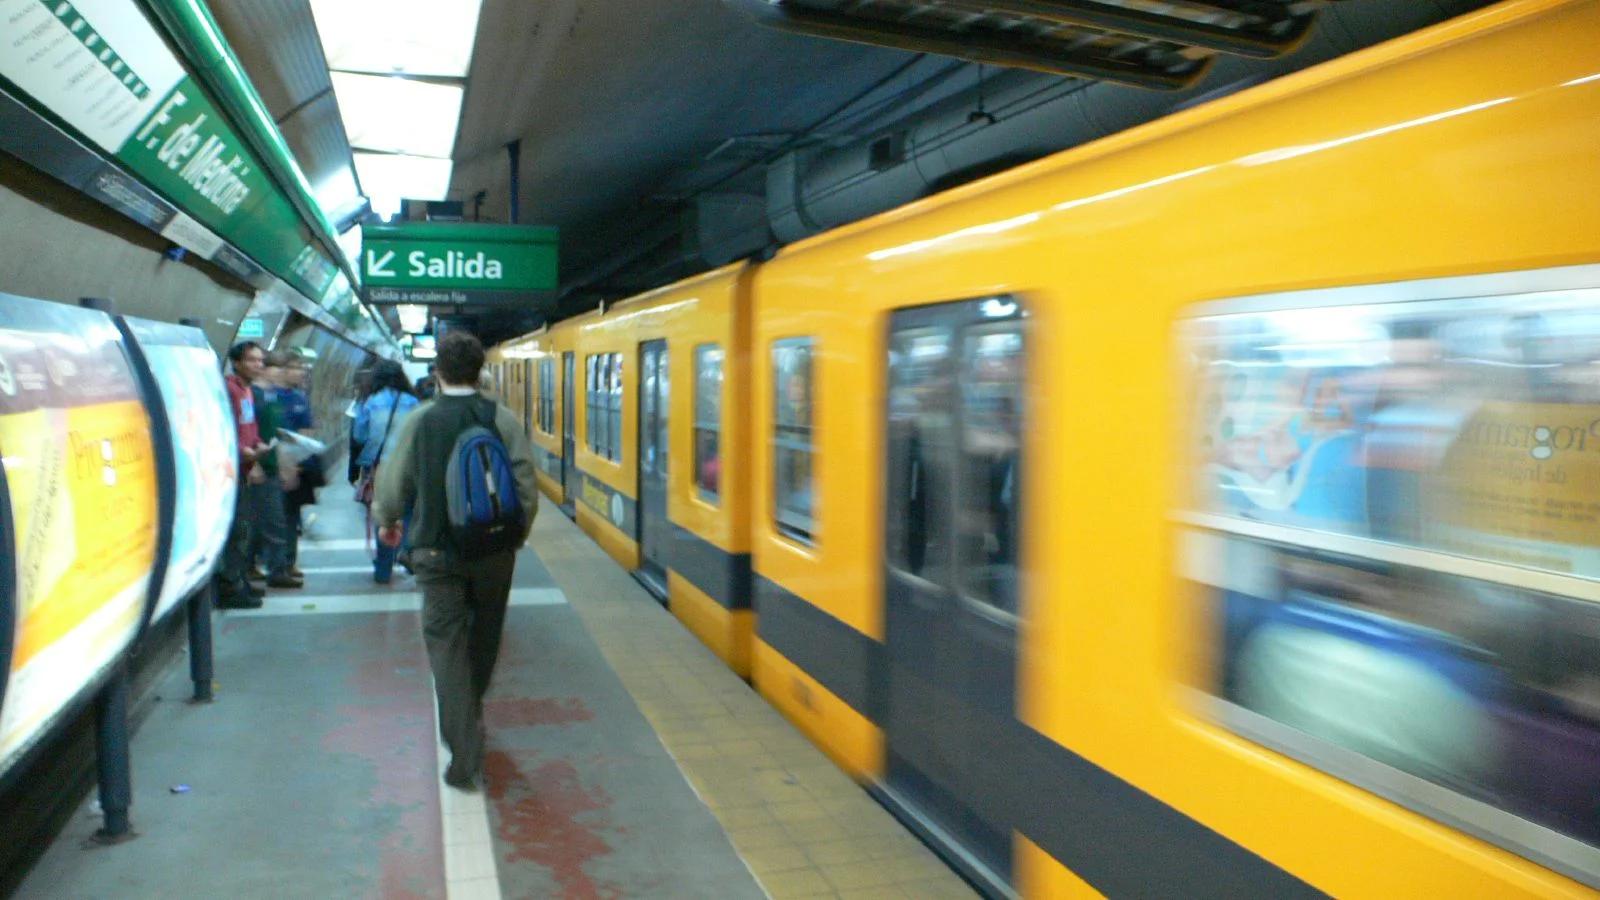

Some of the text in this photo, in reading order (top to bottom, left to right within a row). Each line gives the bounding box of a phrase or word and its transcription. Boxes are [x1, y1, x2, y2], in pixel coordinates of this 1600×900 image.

[157, 112, 207, 170] de
[408, 250, 503, 279] Salida
[369, 287, 399, 301] Salida
